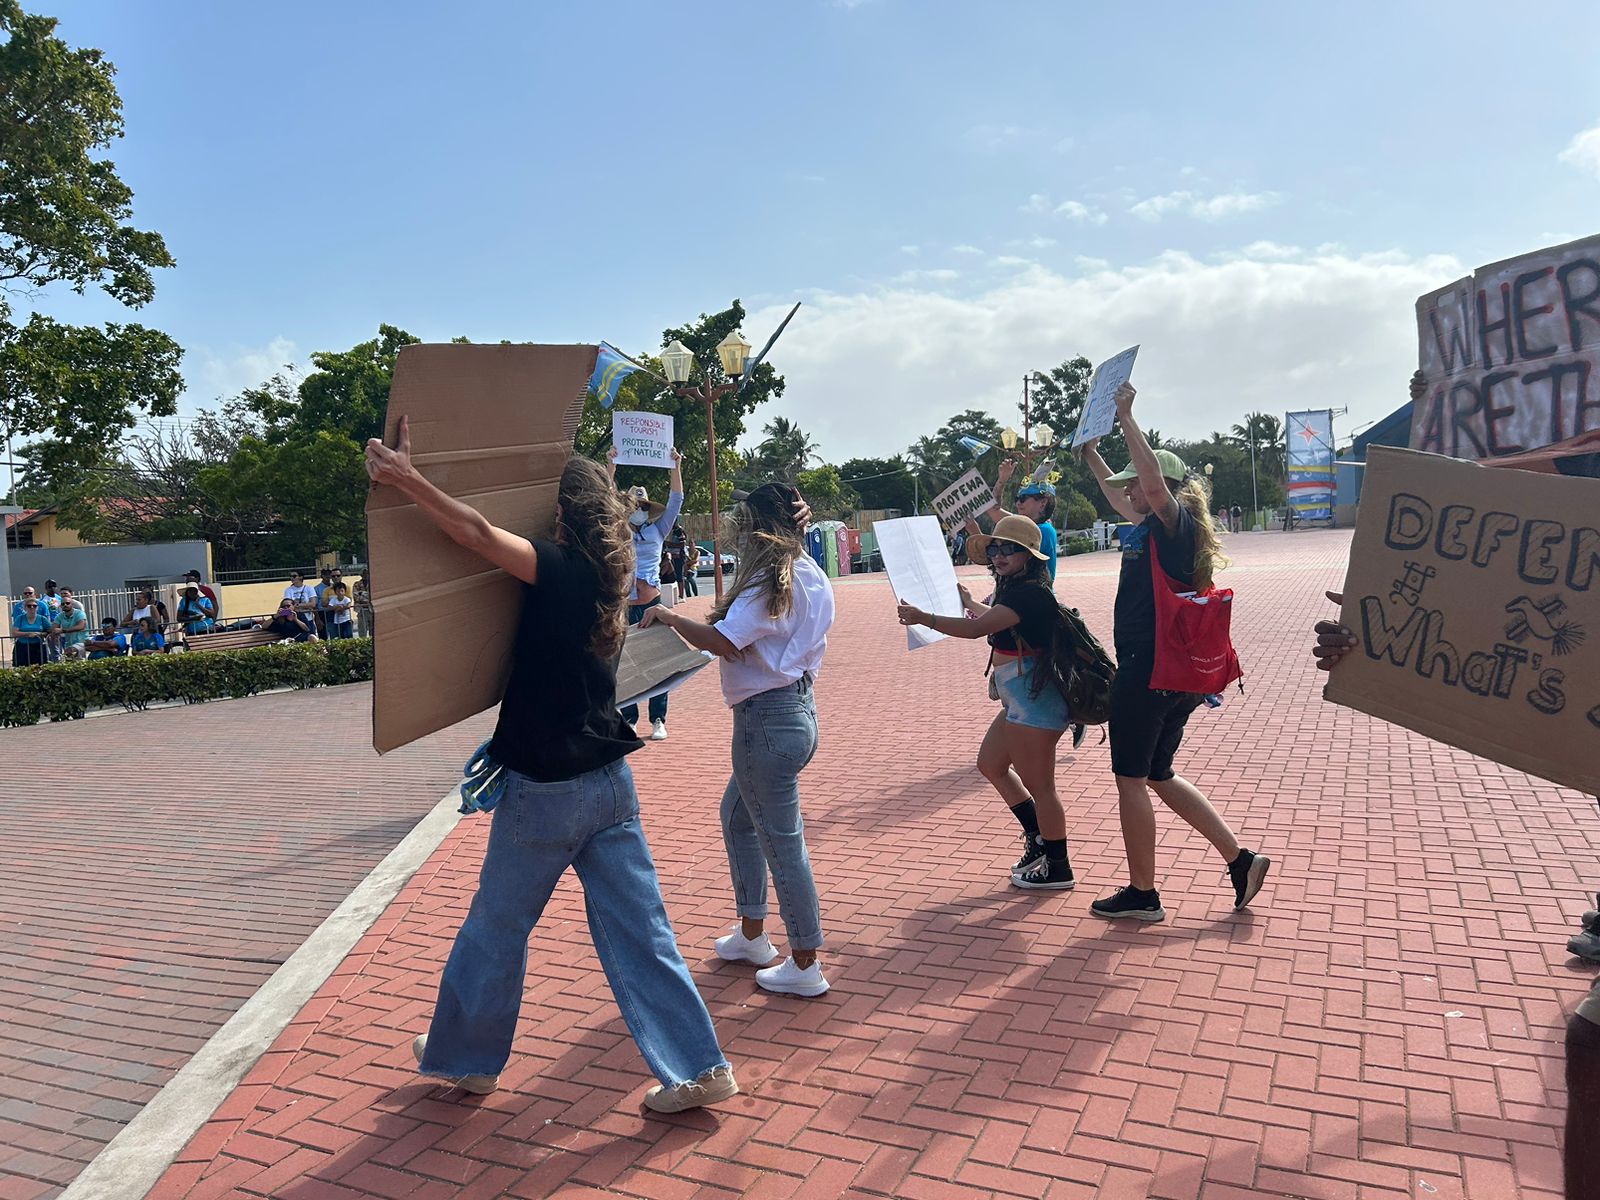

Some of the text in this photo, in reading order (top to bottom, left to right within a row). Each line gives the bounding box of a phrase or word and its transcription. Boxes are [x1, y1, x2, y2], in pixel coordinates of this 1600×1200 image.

[621, 418, 665, 429] RESPONSIBLE
[630, 427, 658, 436] TOURISM
[622, 438, 668, 450] PROTECT OUR
[945, 489, 993, 529] PACHAMAMA
